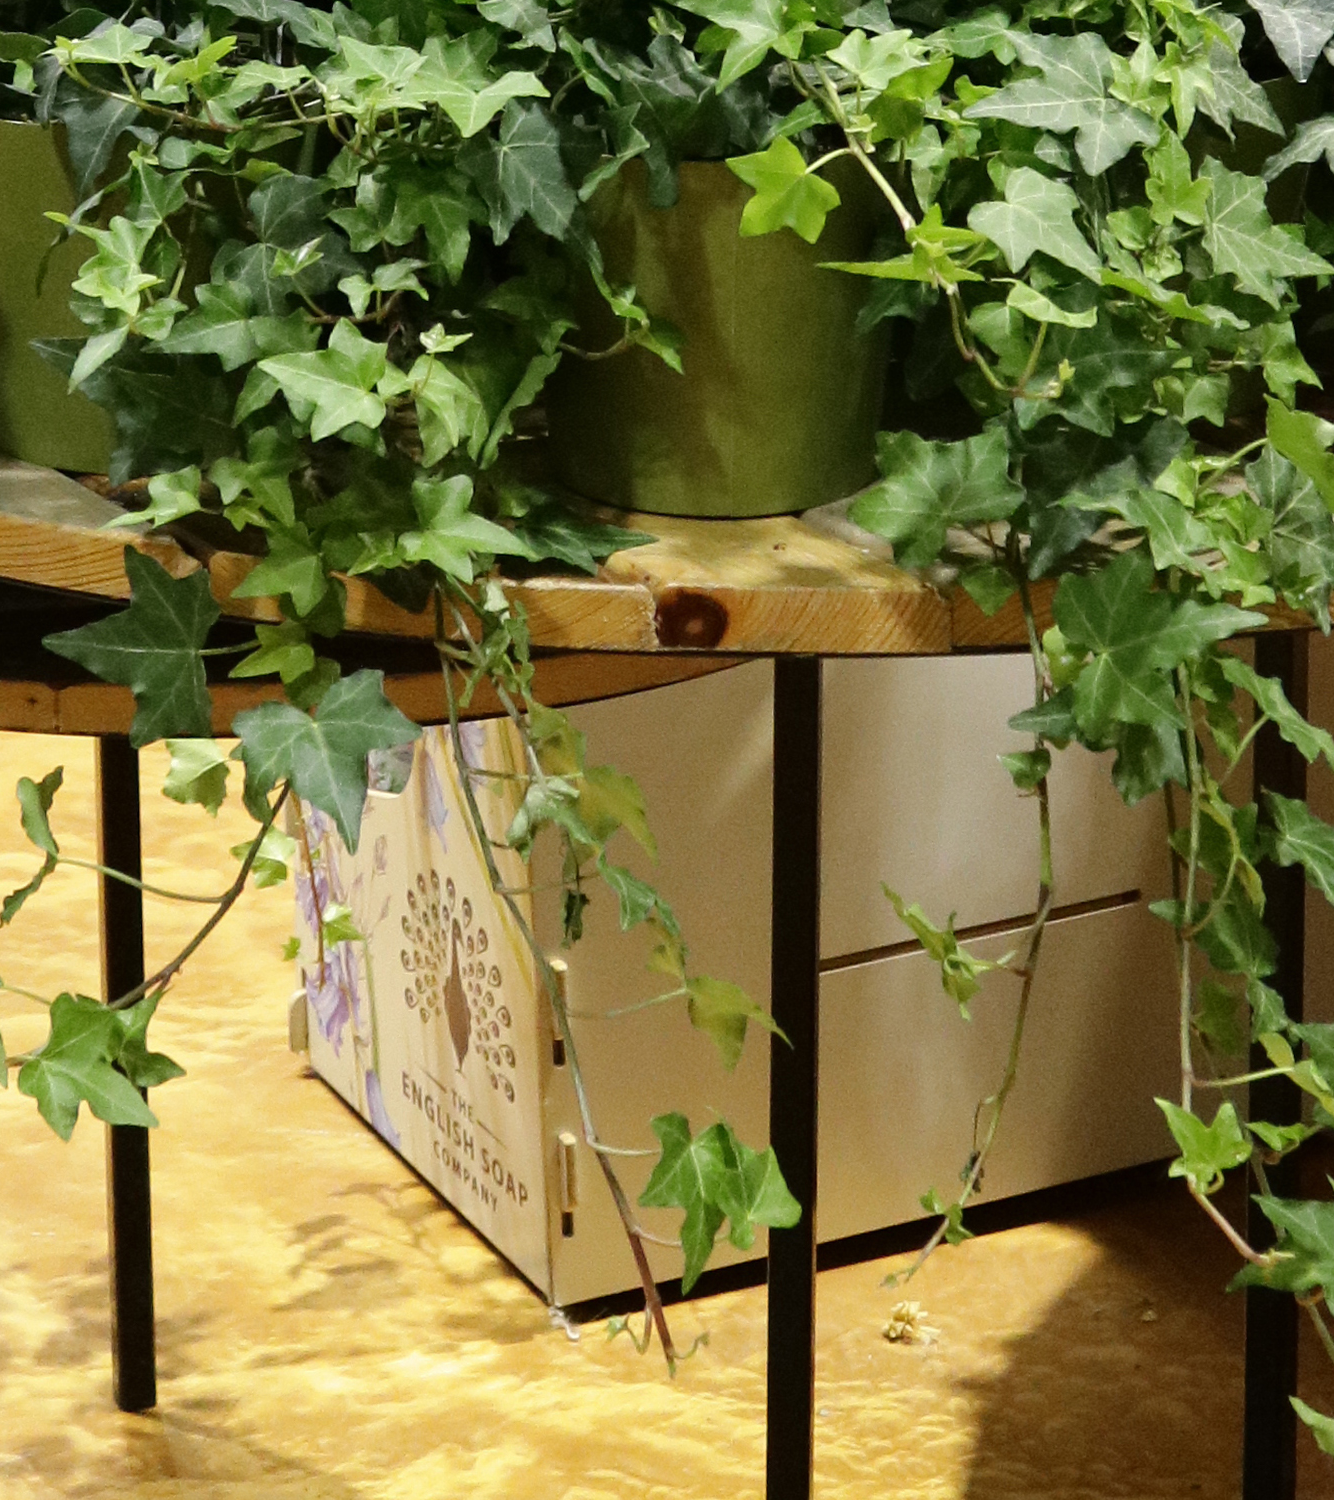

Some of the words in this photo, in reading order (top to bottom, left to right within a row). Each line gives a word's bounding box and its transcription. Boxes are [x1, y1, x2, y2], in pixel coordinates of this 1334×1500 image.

[401, 1070, 475, 1160] ENGLISH
[481, 1147, 528, 1207] SOAP
[451, 1088, 474, 1123] THE
[432, 1140, 498, 1212] COMPANY
